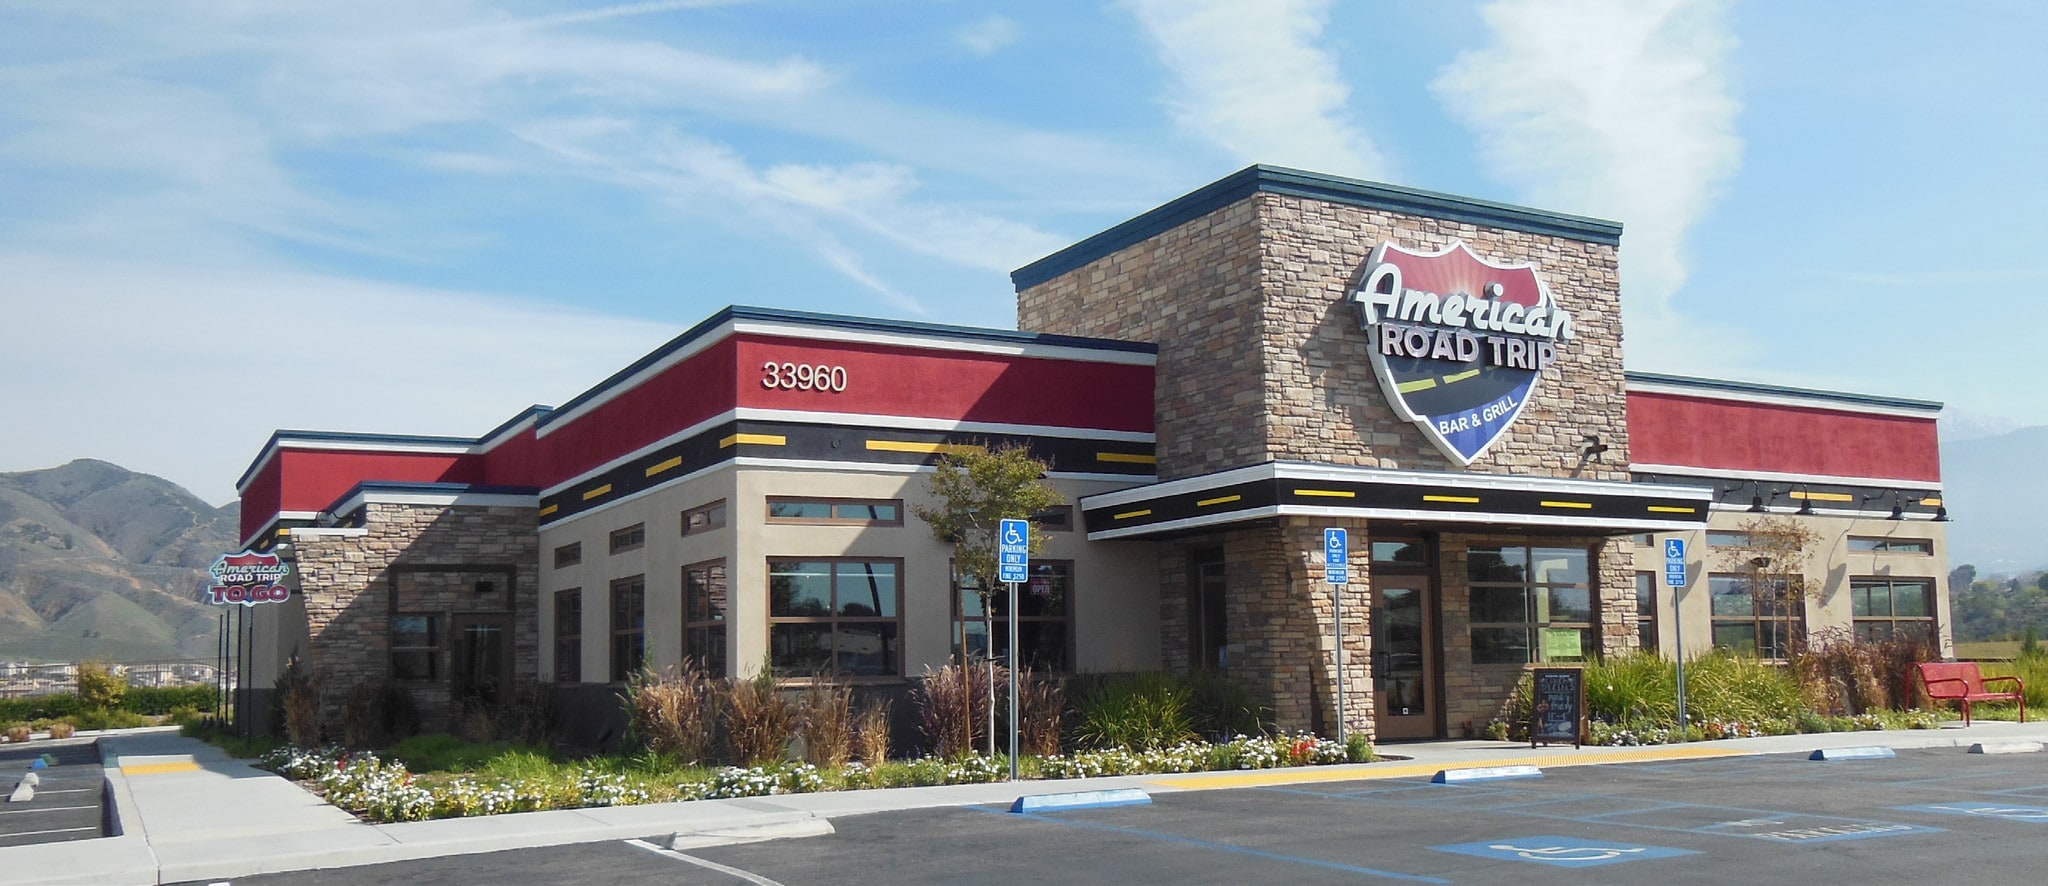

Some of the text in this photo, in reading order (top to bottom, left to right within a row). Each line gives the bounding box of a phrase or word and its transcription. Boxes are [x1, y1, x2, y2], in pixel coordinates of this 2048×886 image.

[1355, 262, 1575, 340] American
[1380, 322, 1558, 371] ROAD TRIP
[762, 361, 847, 392] 33960
[1439, 395, 1518, 436] BAR & GRILL
[1001, 544, 1027, 553] PARKING
[211, 560, 287, 575] American
[1006, 554, 1021, 563] ONLY
[220, 573, 281, 582] ROAD TRIP
[212, 584, 290, 603] TO GO
